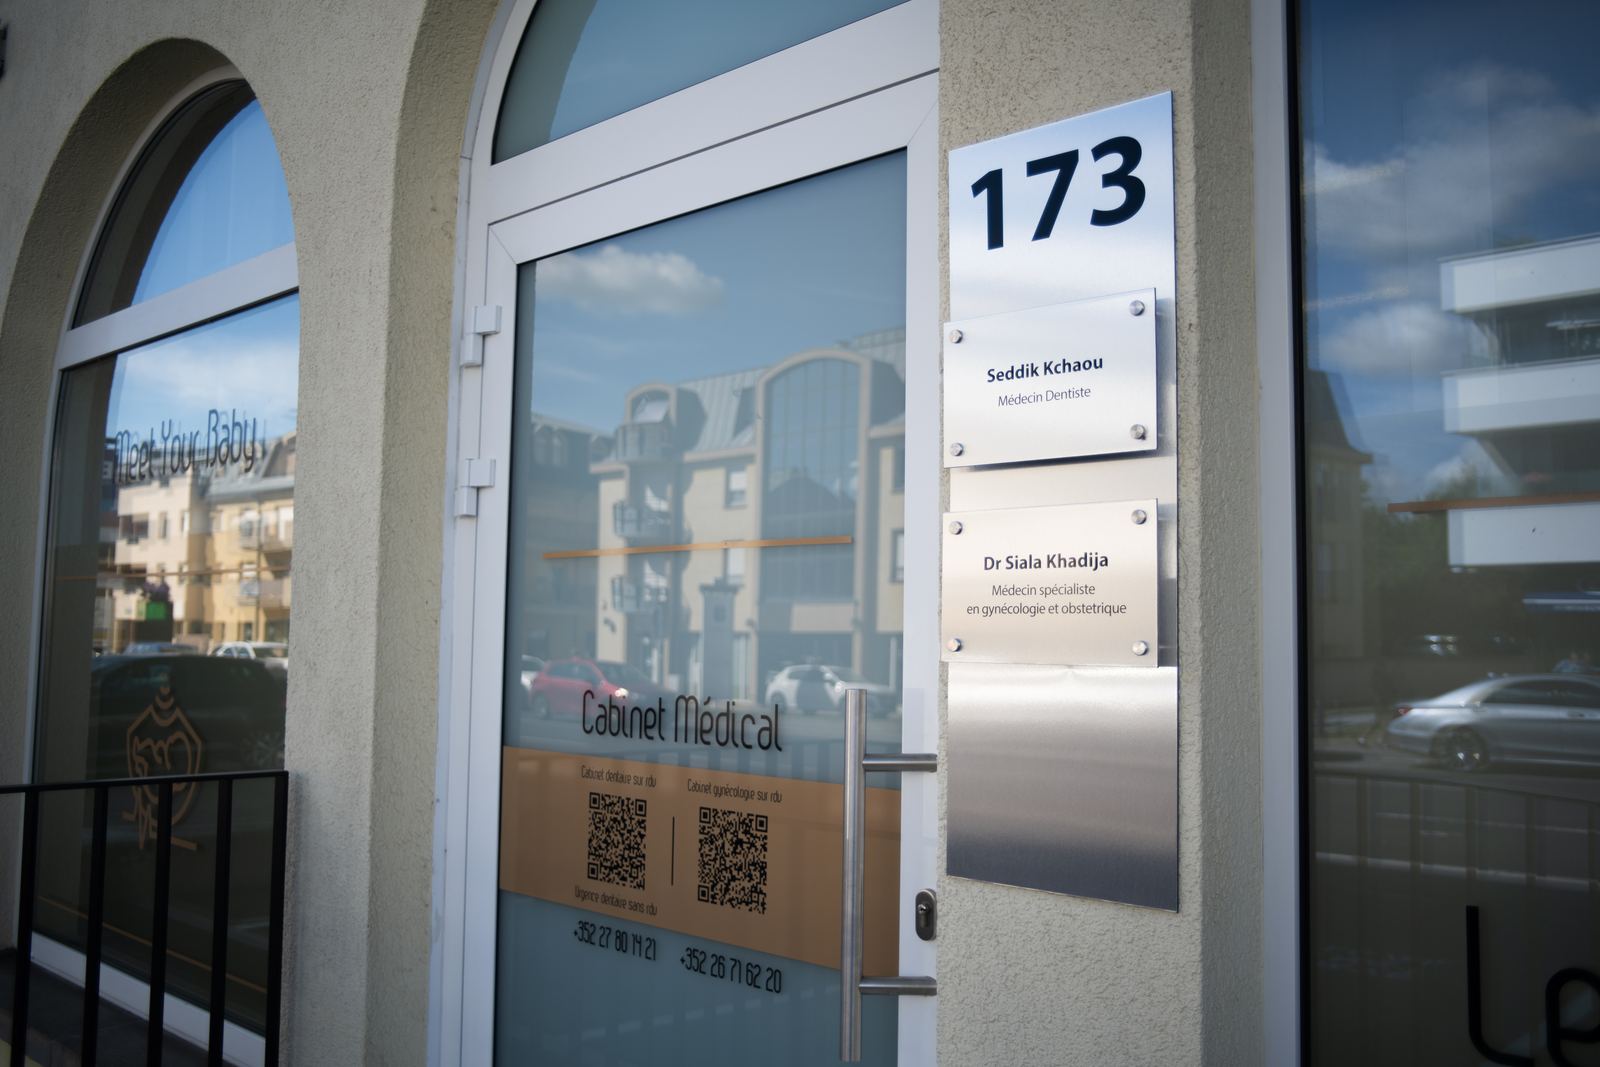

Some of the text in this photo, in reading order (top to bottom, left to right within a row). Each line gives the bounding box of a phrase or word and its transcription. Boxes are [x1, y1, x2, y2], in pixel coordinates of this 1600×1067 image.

[971, 135, 1147, 250] 173
[986, 357, 1103, 383] Seddik Kchaou
[998, 386, 1091, 407] Médecin Dentiste
[115, 407, 257, 482] Meet Your Baby
[983, 552, 1109, 573] Dr Siala Khadija
[991, 583, 1095, 598] Médecin spécialiste
[966, 602, 1127, 618] en gynécologie et obstetrique
[582, 688, 783, 753] Cabinet Médical
[580, 764, 605, 781] Cabinet
[605, 769, 632, 785] dentaire
[633, 774, 643, 786] sur
[687, 778, 712, 795] Cabinet
[757, 789, 768, 801] sur
[574, 886, 600, 903] Urgence
[601, 892, 627, 909] dentaire
[628, 899, 645, 914] sans
[573, 920, 657, 962] +352 27 80 14 21
[680, 947, 782, 994] +352 26 71 62 20
